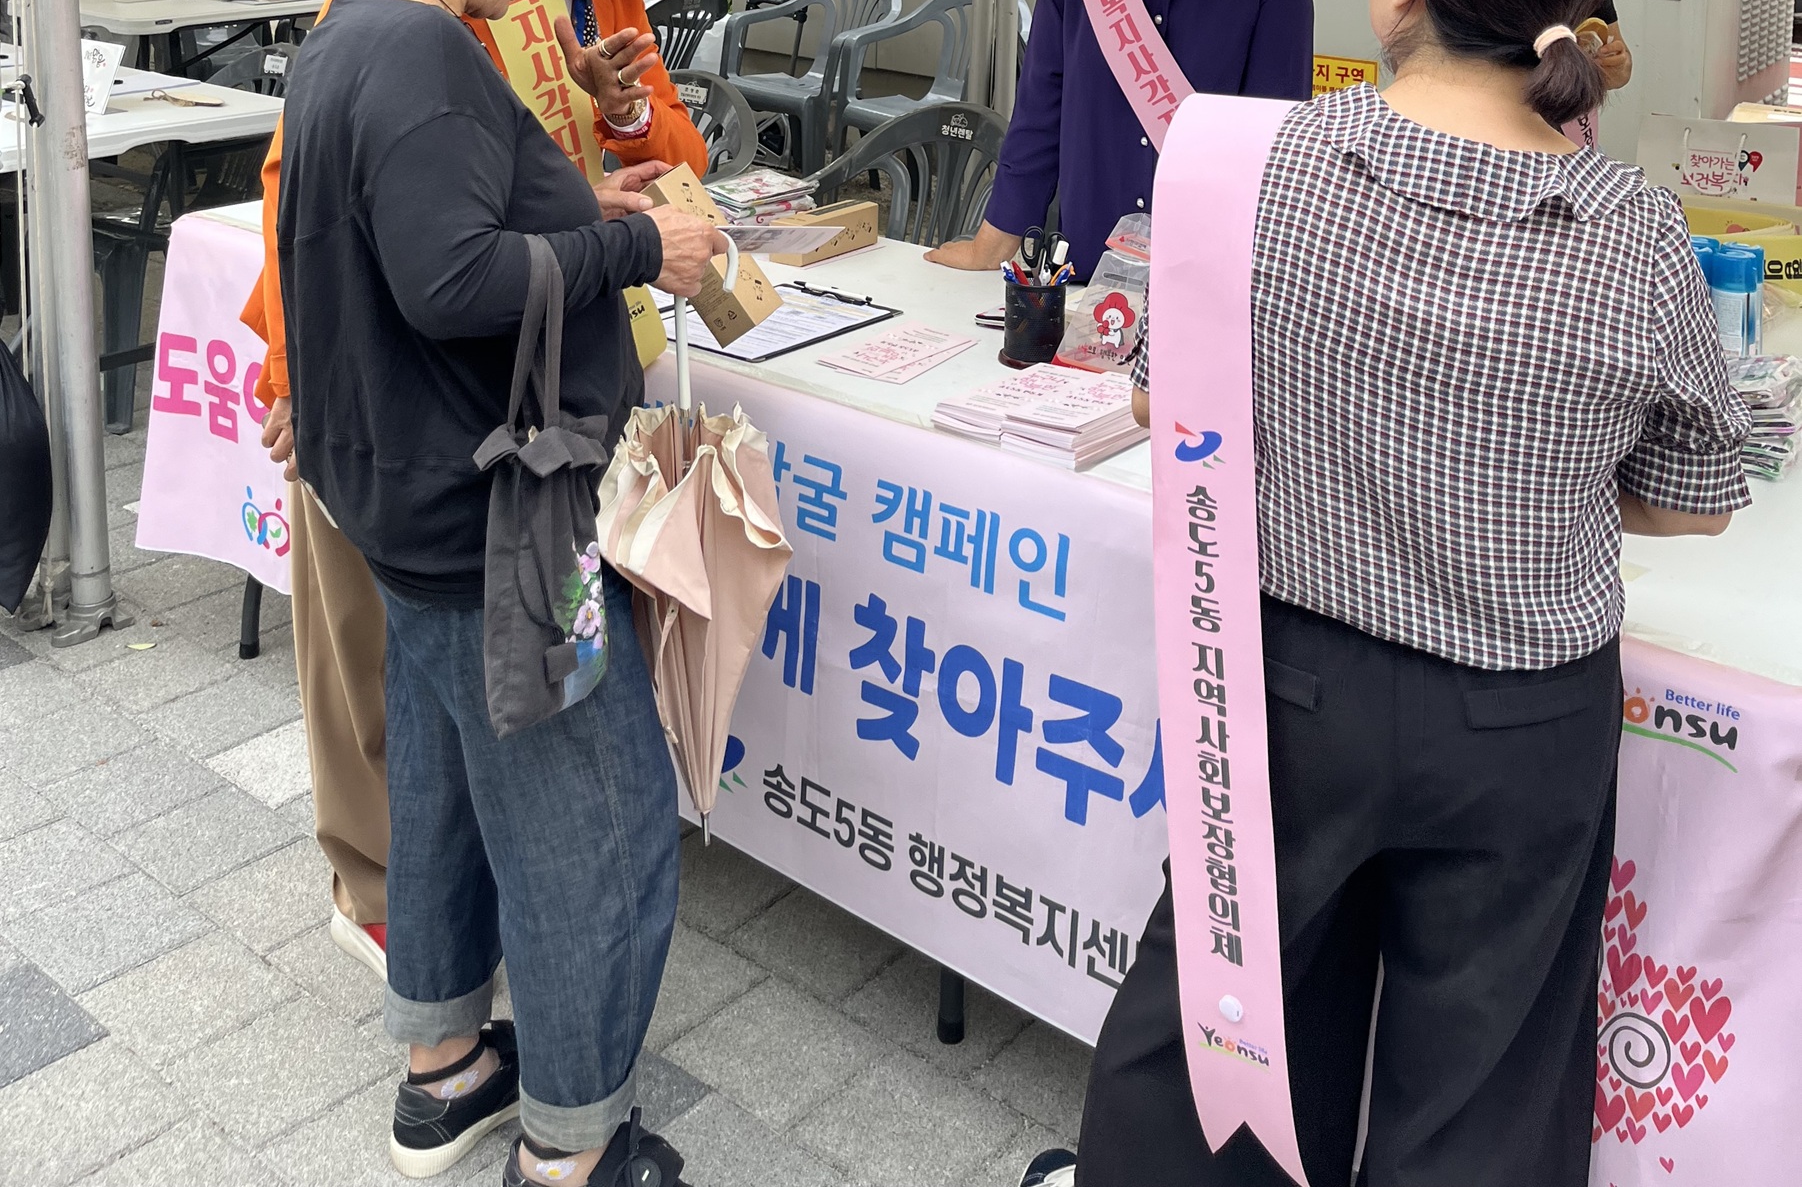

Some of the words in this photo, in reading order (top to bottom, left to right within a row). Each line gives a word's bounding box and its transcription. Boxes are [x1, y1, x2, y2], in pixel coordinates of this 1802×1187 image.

[1335, 66, 1364, 84] 구역
[941, 124, 974, 140] 청년렌탈
[1690, 154, 1735, 172] 찾아가는
[871, 478, 1070, 622] 캠페인
[1186, 485, 1223, 633] 송도5동
[1624, 690, 1738, 750] onsu
[1665, 688, 1713, 712] Better
[1716, 702, 1740, 720] life
[1191, 641, 1243, 968] 지역사회보장협의체
[762, 763, 895, 872] 송도5동
[908, 831, 1140, 990] 행정복지센
[1197, 1022, 1270, 1066] Yeonsu
